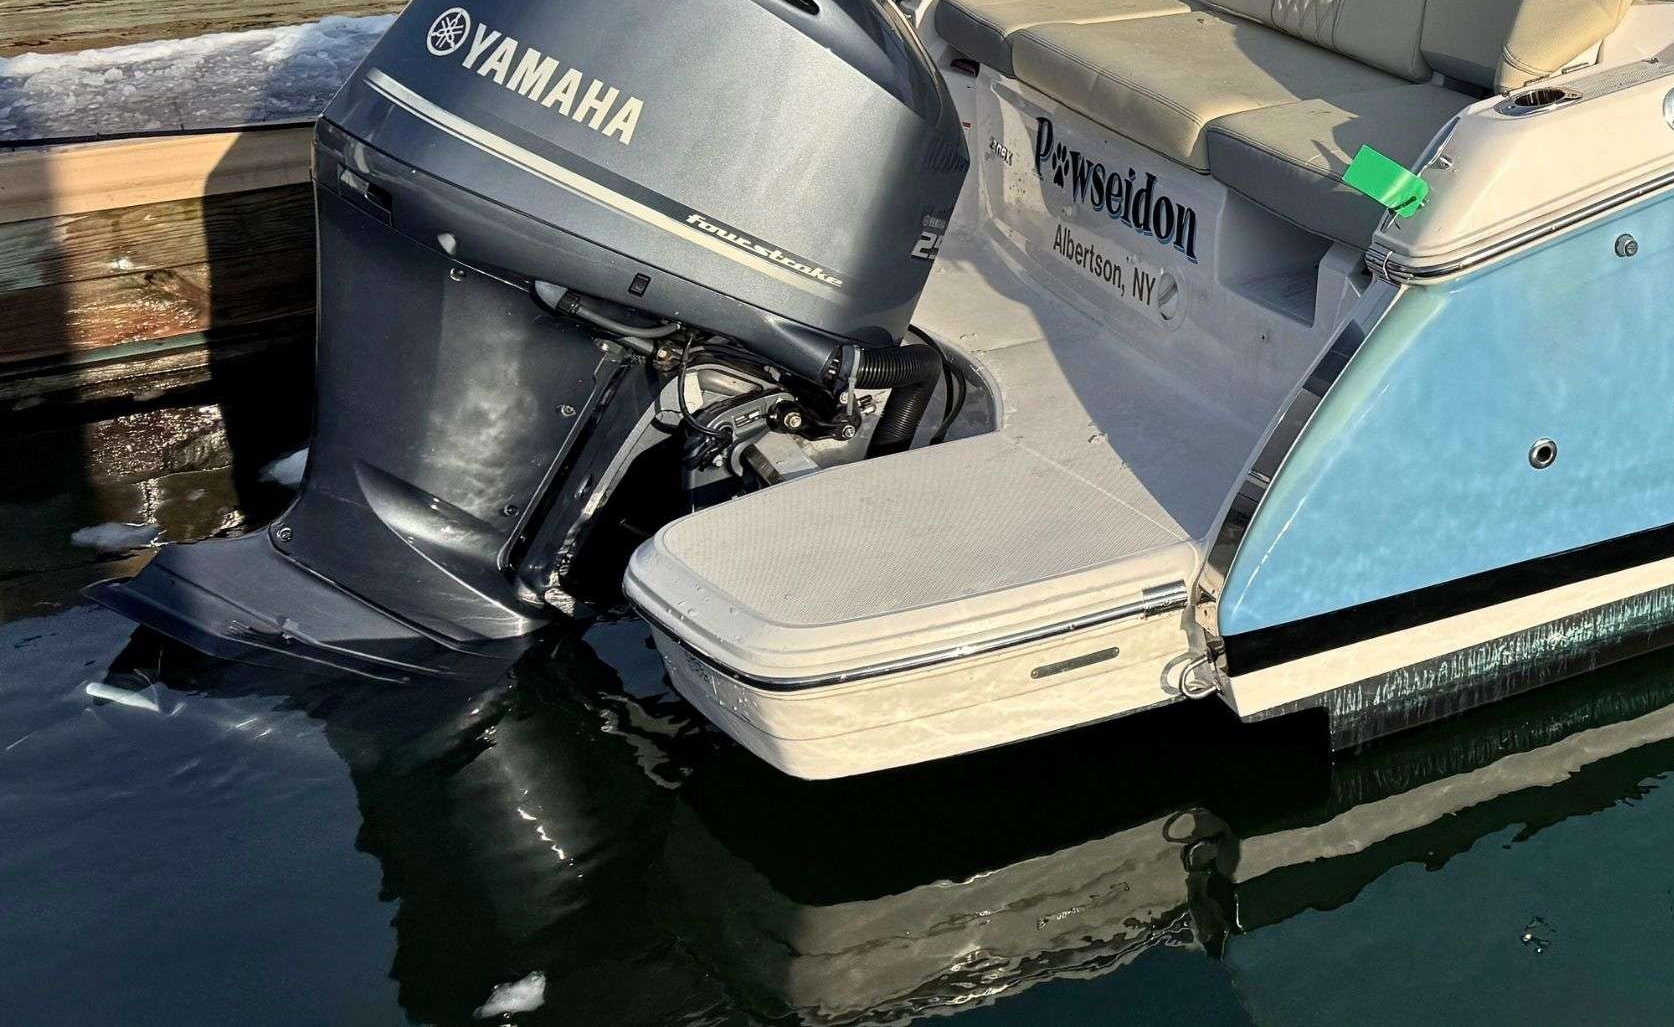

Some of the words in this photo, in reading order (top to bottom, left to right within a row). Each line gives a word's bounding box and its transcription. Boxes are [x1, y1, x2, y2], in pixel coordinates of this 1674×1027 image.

[462, 23, 645, 146] YAMAHA
[685, 213, 845, 288] fourstroke
[1052, 224, 1127, 294] Albertson,
[1131, 270, 1157, 307] NY
